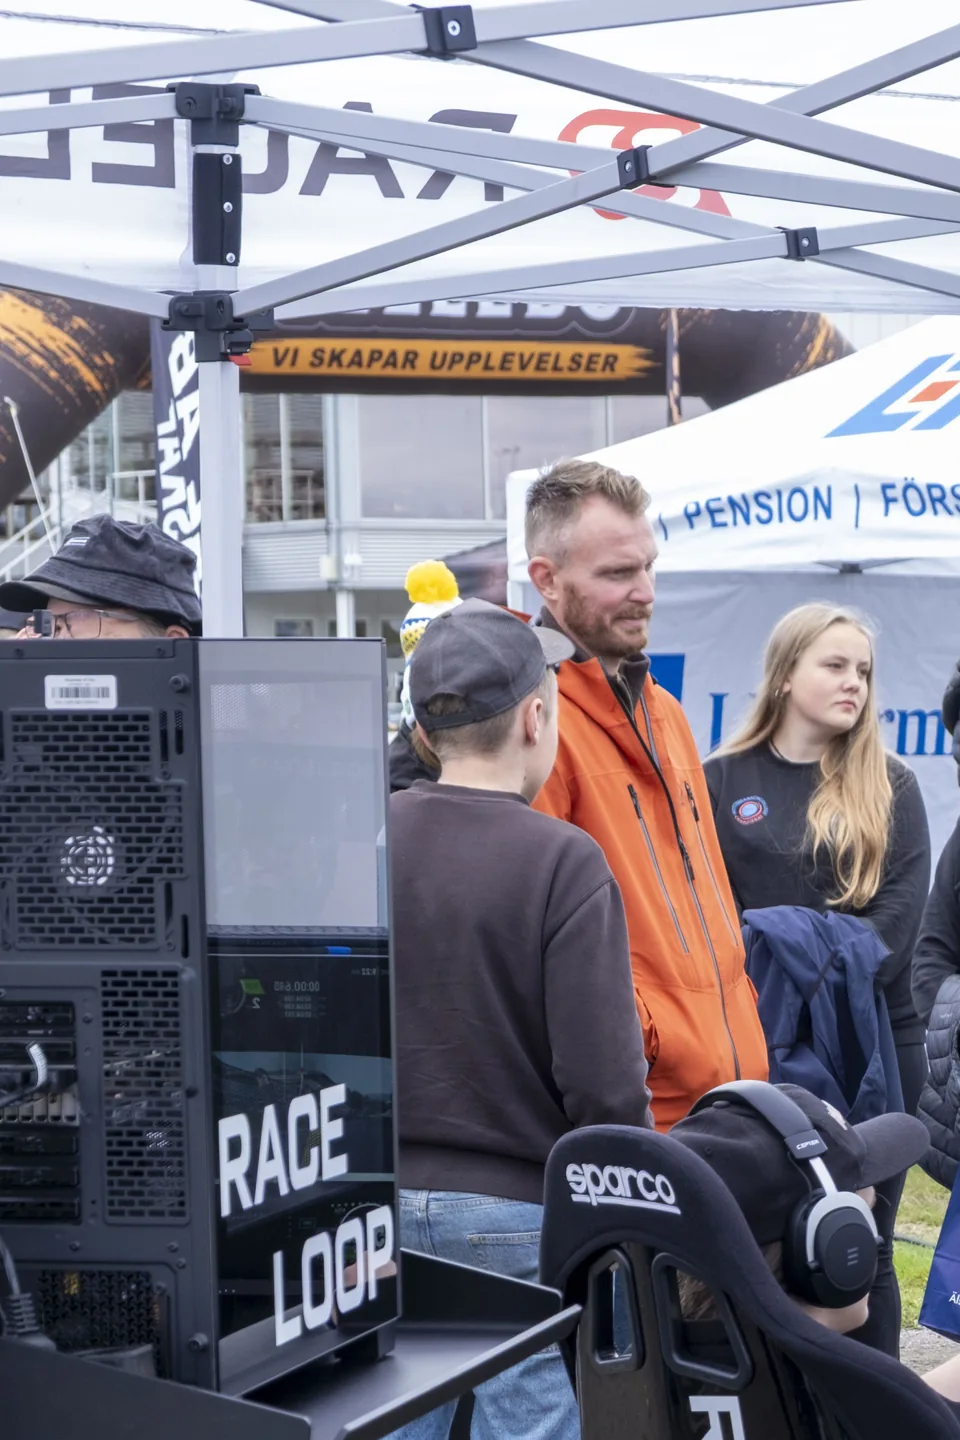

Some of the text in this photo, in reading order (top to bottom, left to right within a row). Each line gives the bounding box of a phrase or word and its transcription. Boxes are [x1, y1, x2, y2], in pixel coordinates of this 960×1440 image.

[272, 347, 619, 373] VI SKAPAR UPPLEVELSER
[683, 484, 833, 529] PENSION
[218, 1083, 349, 1218] RACE
[565, 1162, 677, 1207] sparco
[272, 1204, 395, 1347] LOOP
